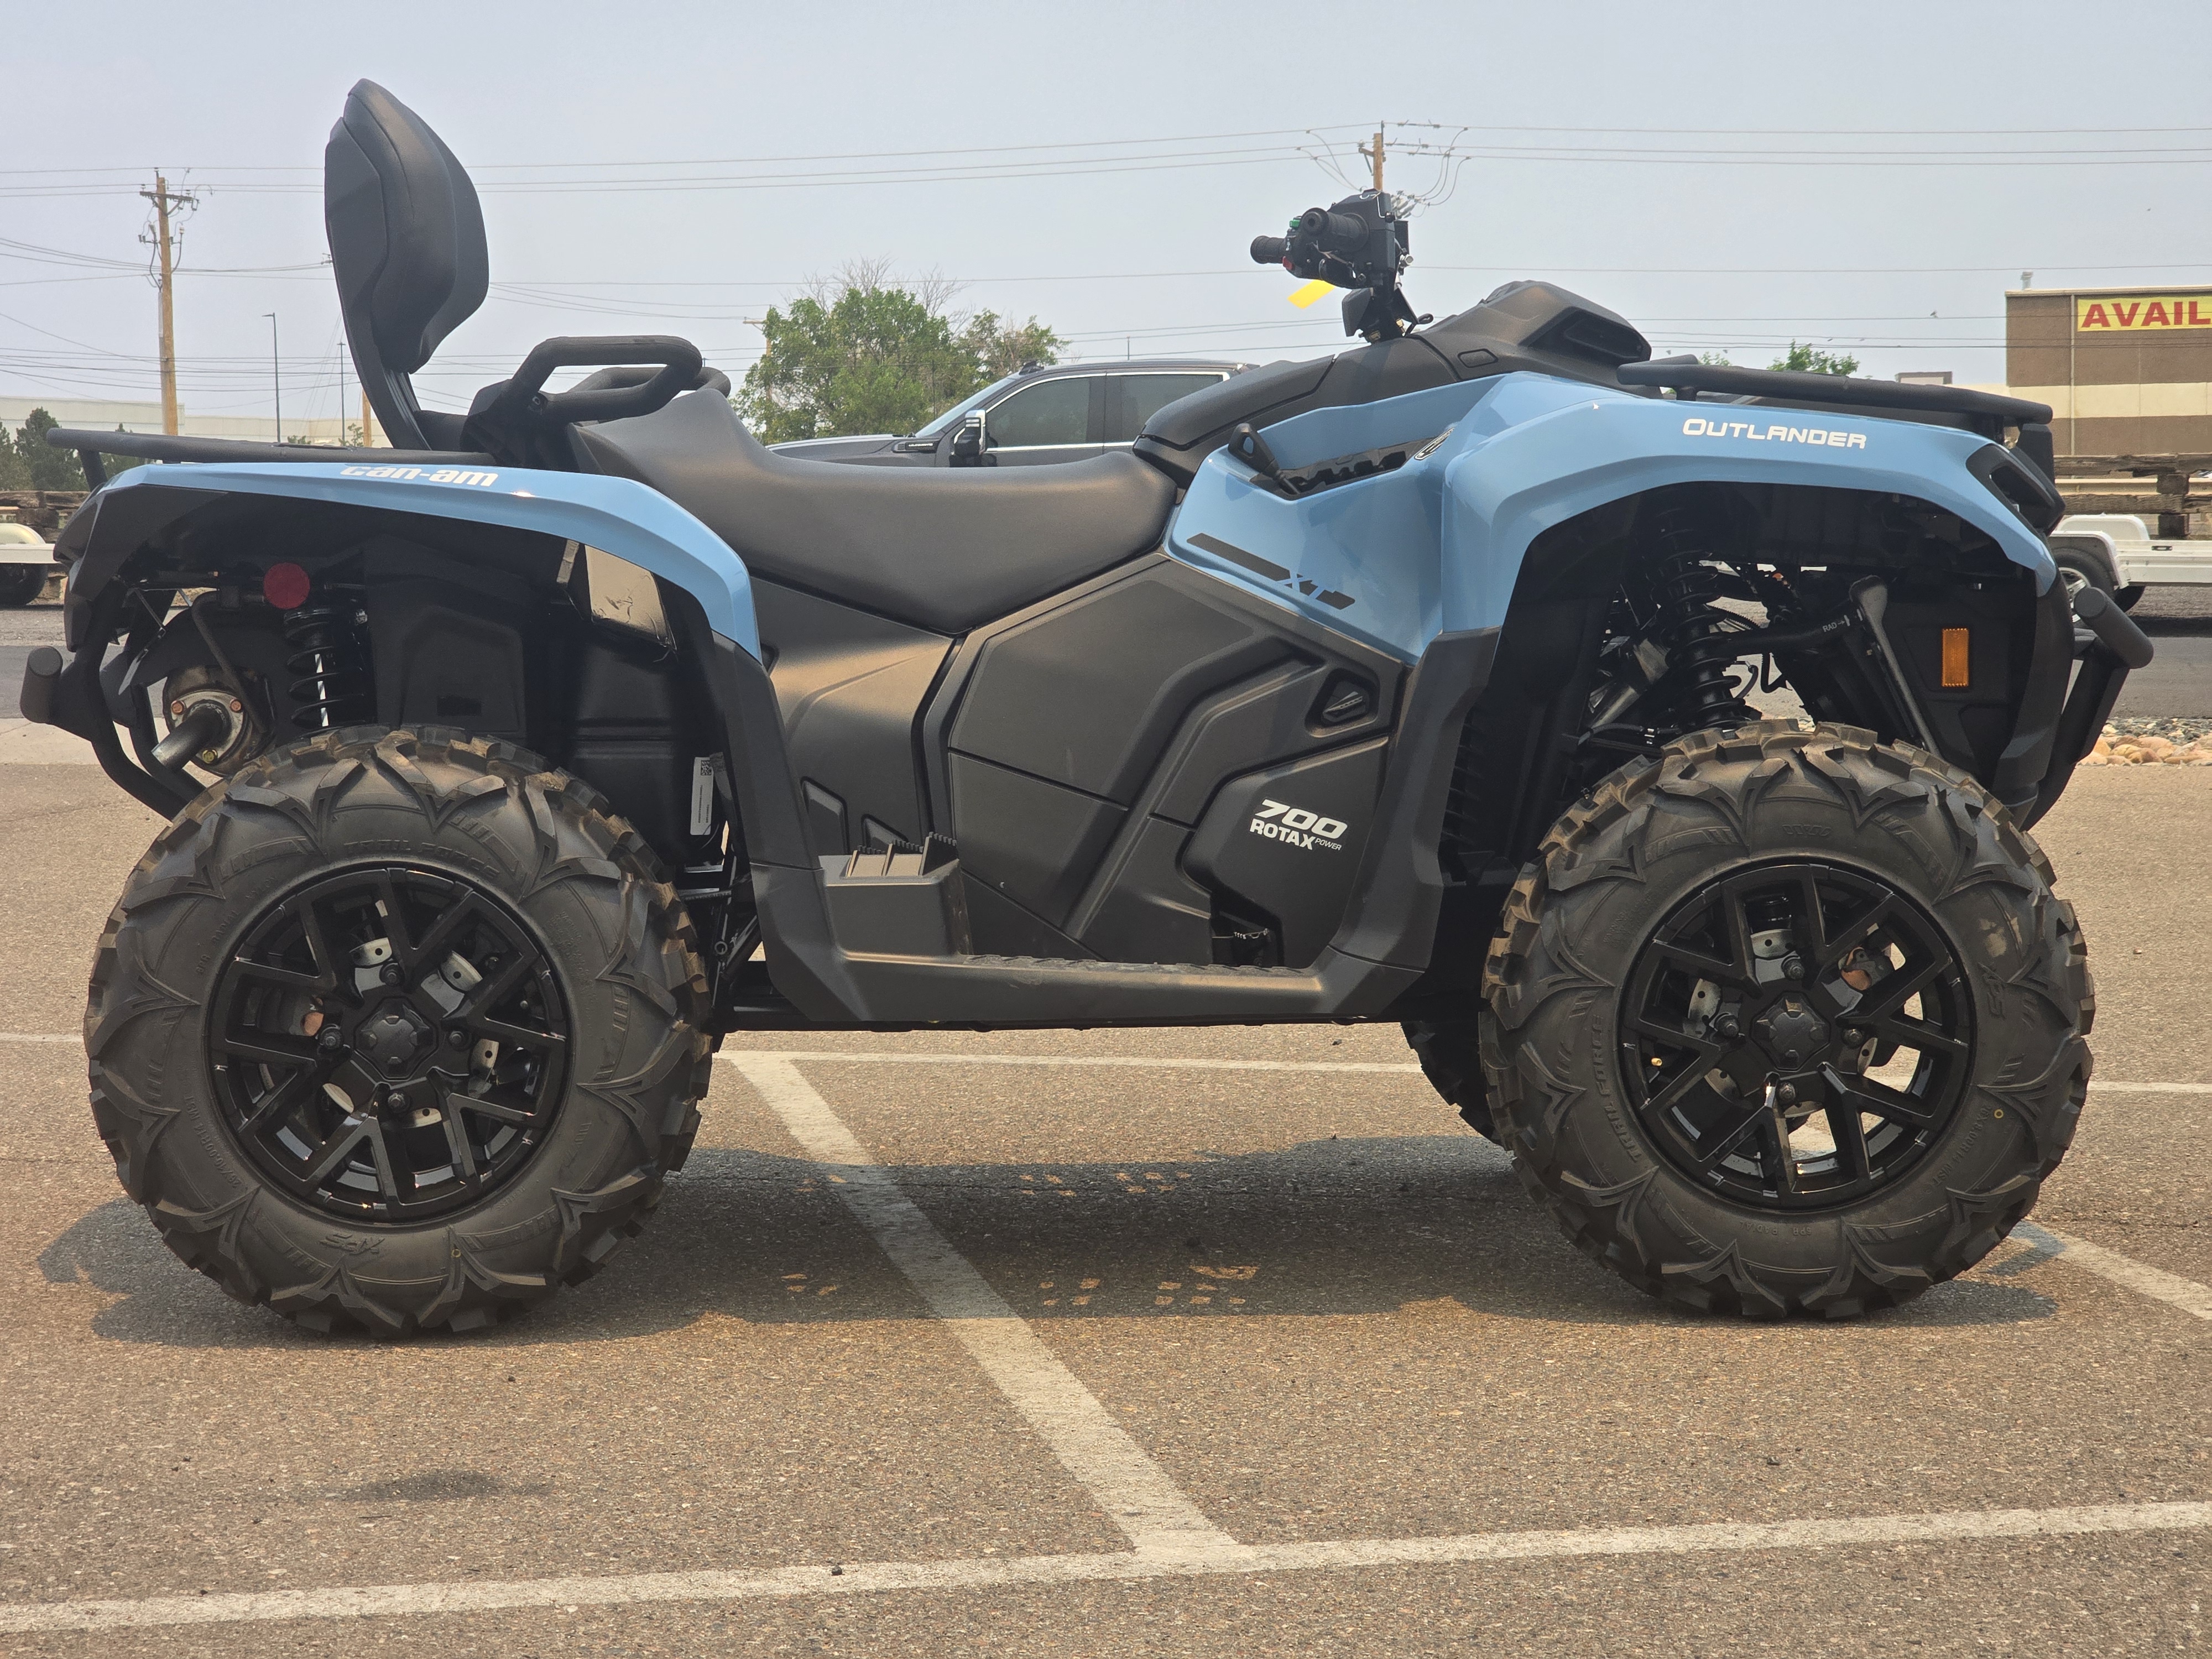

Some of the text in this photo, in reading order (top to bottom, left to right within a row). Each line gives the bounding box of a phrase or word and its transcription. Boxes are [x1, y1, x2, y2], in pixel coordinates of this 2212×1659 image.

[1683, 419, 1867, 449] OUTLANDER
[340, 466, 499, 487] can-am
[1822, 622, 1837, 632] RAD
[1255, 799, 1348, 839] 700
[1249, 818, 1342, 851] ROTAX POWER
